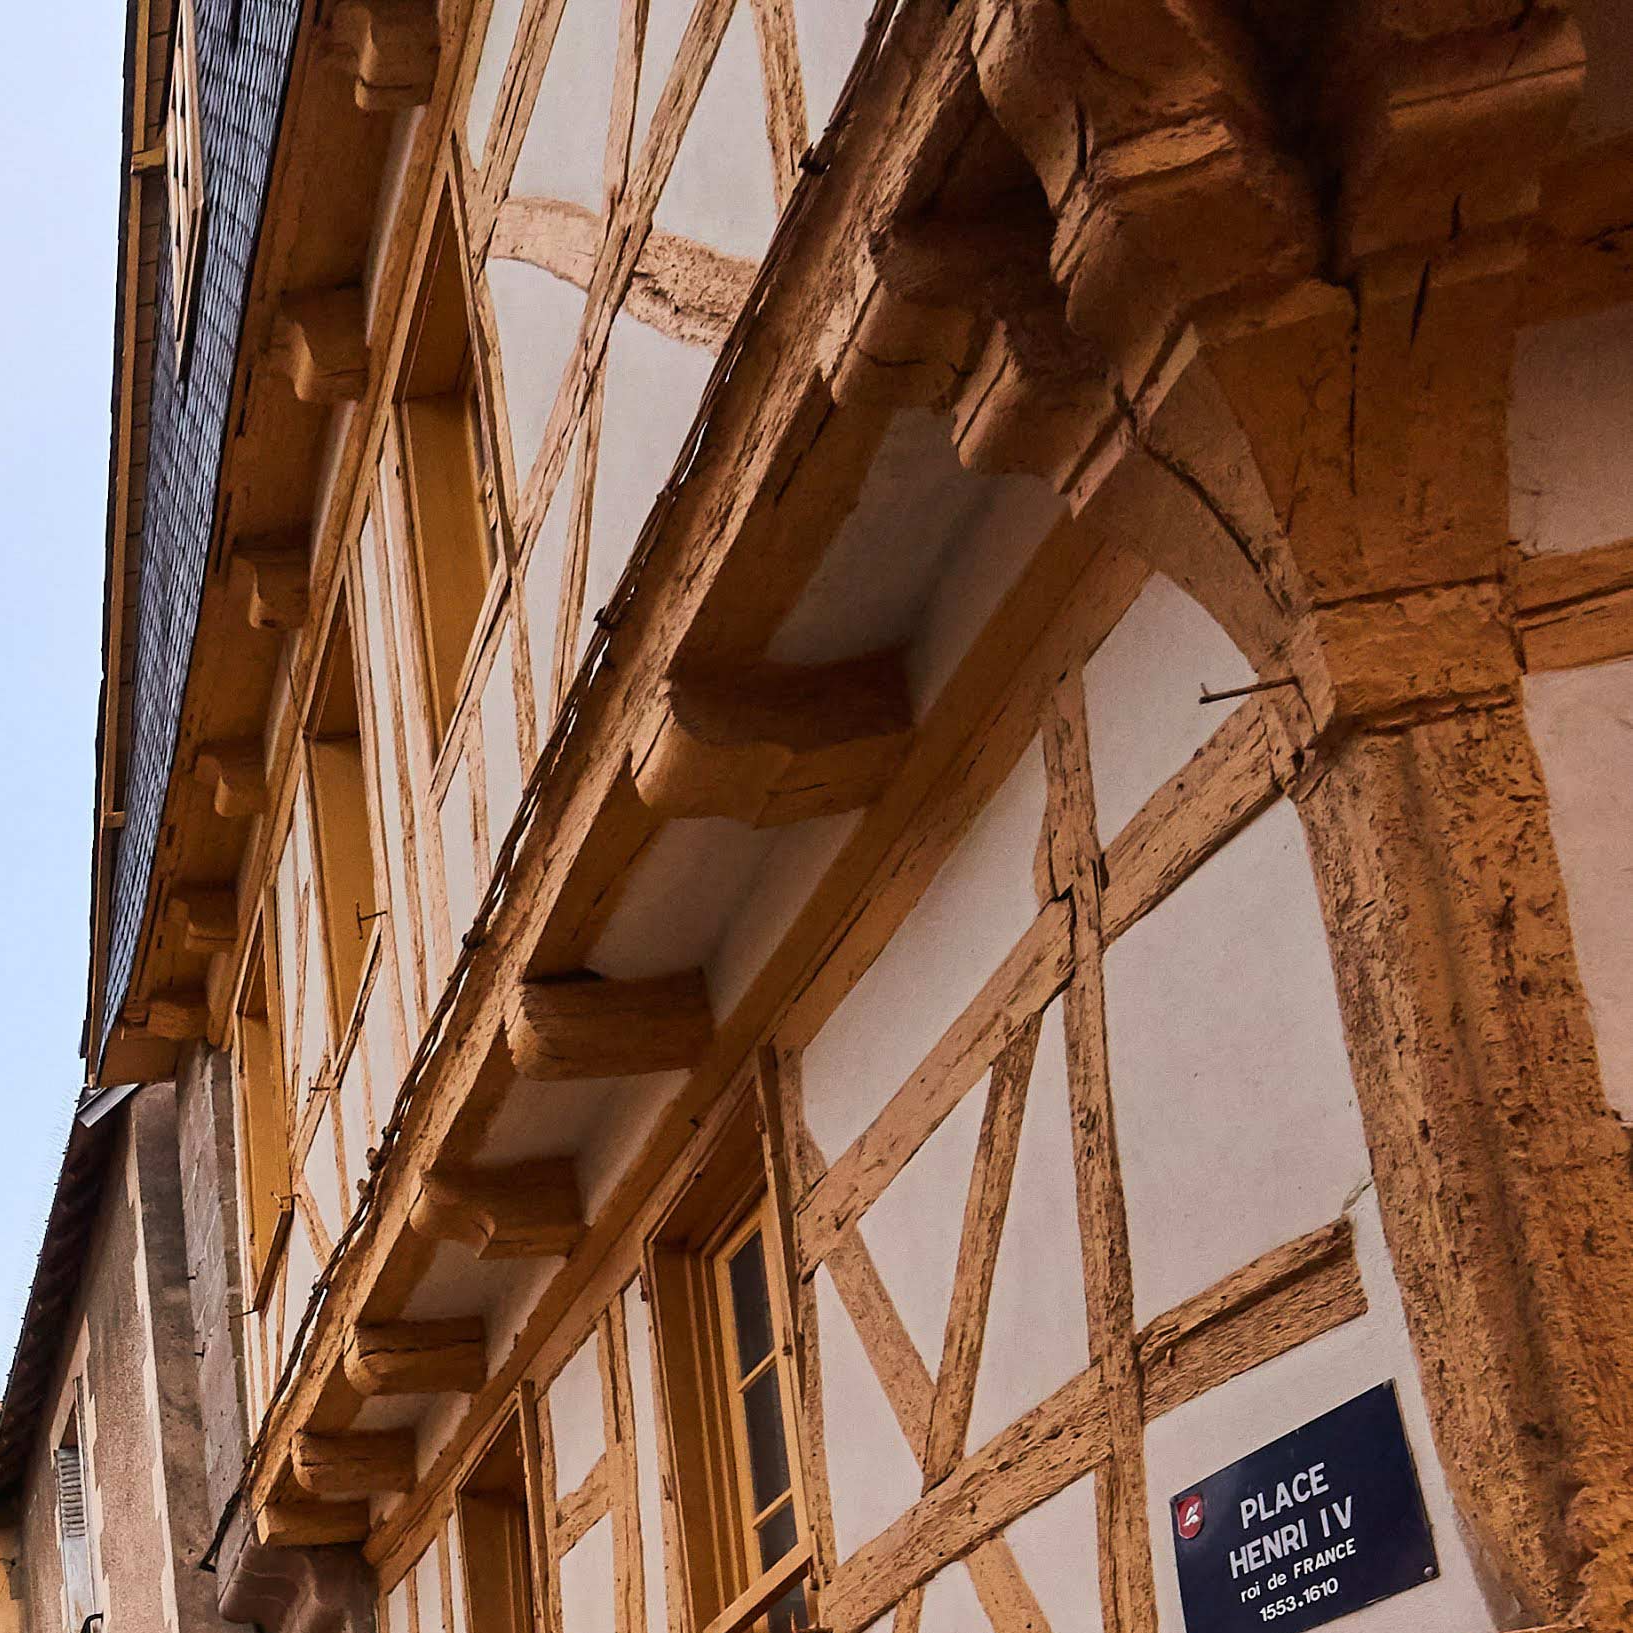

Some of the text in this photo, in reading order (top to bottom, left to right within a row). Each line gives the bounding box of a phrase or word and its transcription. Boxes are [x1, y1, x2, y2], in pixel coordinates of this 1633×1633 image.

[1240, 1462, 1330, 1530] PLACE
[1229, 1495, 1352, 1579] HENRI IV
[1240, 1537, 1357, 1603] roi de FRANCE
